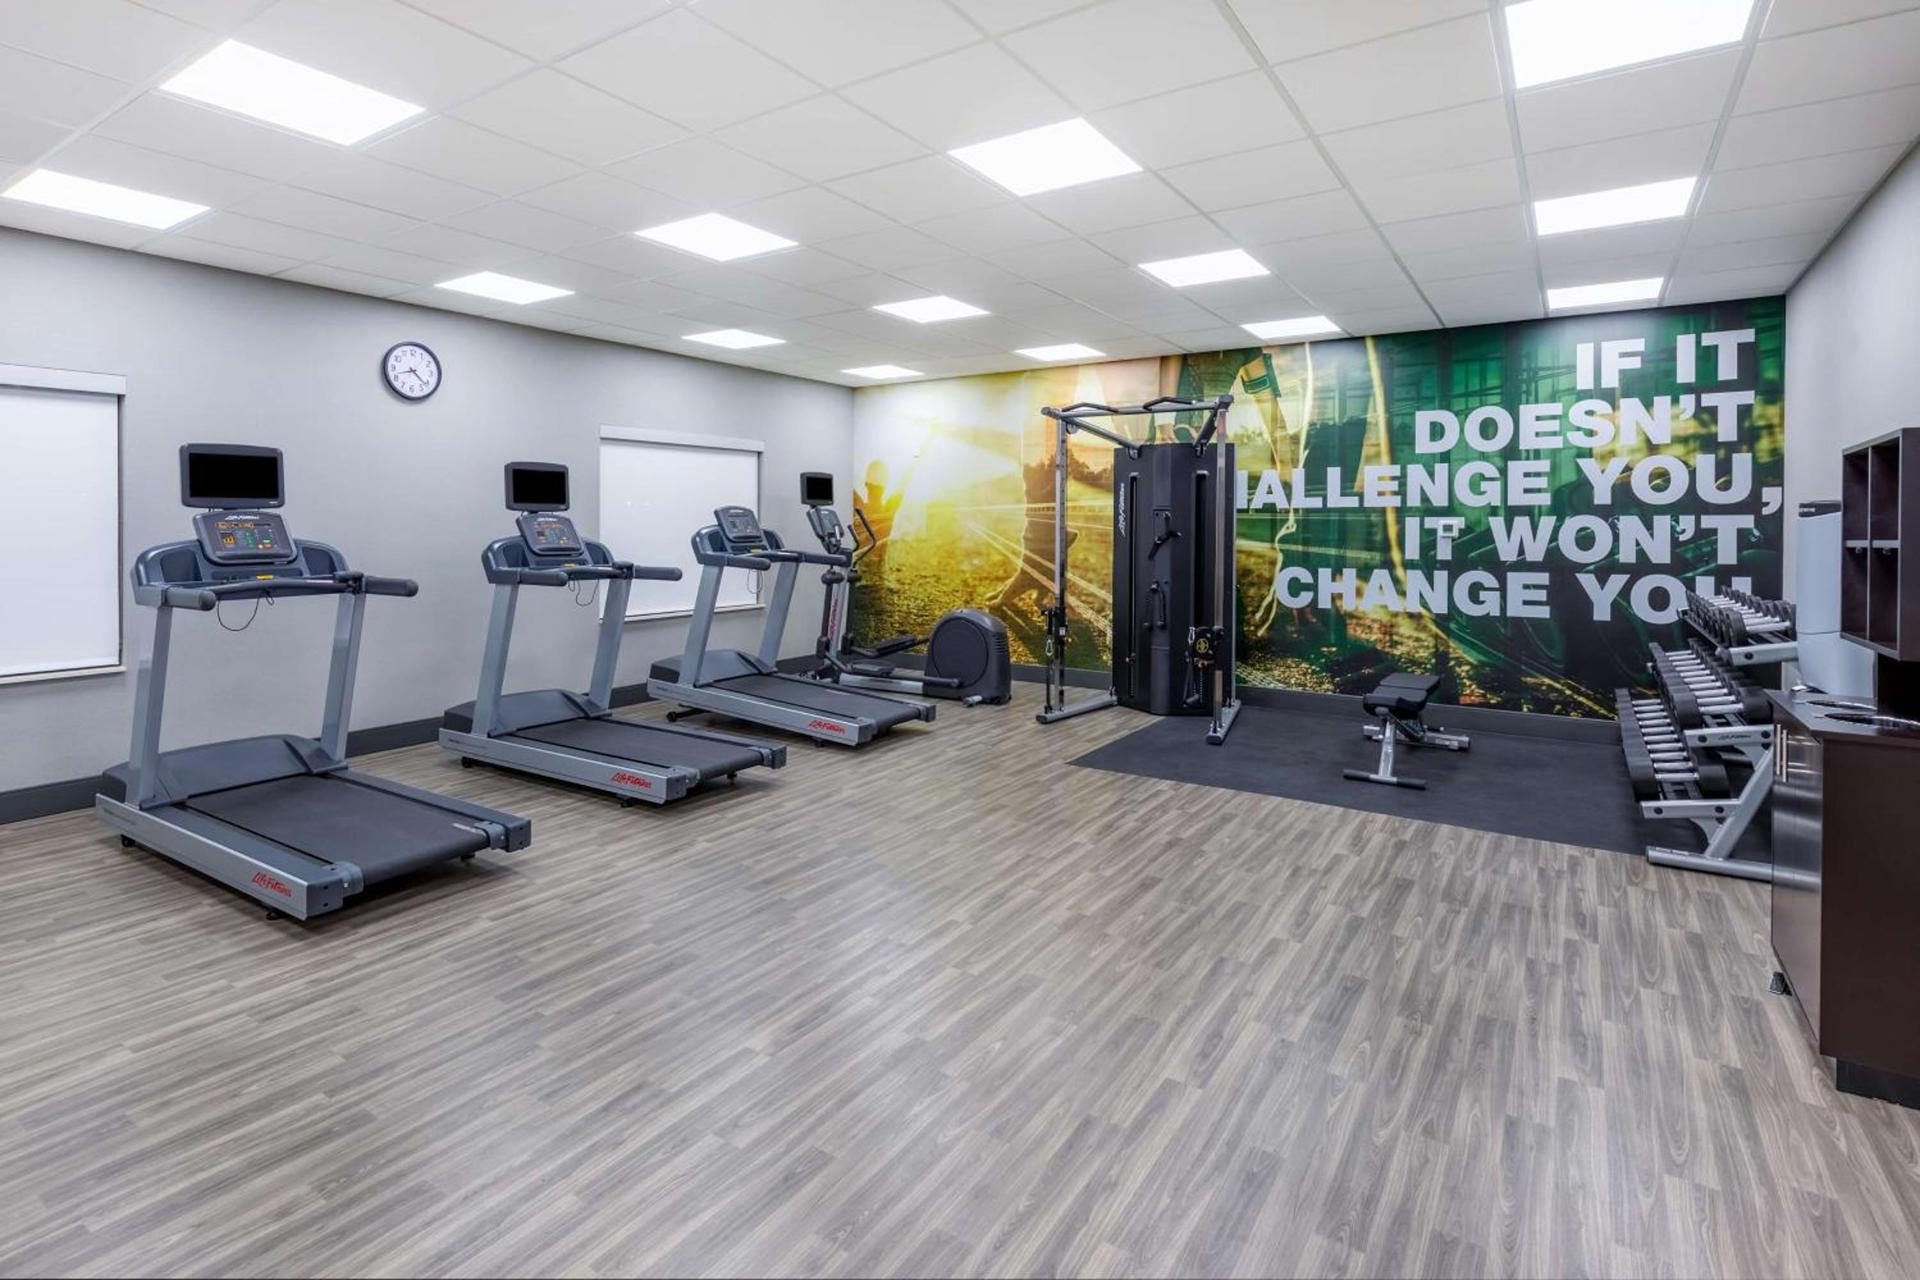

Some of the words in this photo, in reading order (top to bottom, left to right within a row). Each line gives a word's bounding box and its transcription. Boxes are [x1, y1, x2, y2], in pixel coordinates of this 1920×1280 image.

[1576, 338, 1644, 389] IF
[1676, 328, 1756, 384] IT
[1415, 391, 1756, 454] DOESN'T
[1236, 458, 1551, 509] ALLENGE
[1577, 453, 1783, 516] YOU,
[1405, 516, 1465, 560] IT
[1489, 514, 1755, 564] WON'T
[1275, 567, 1551, 618] CHANGE
